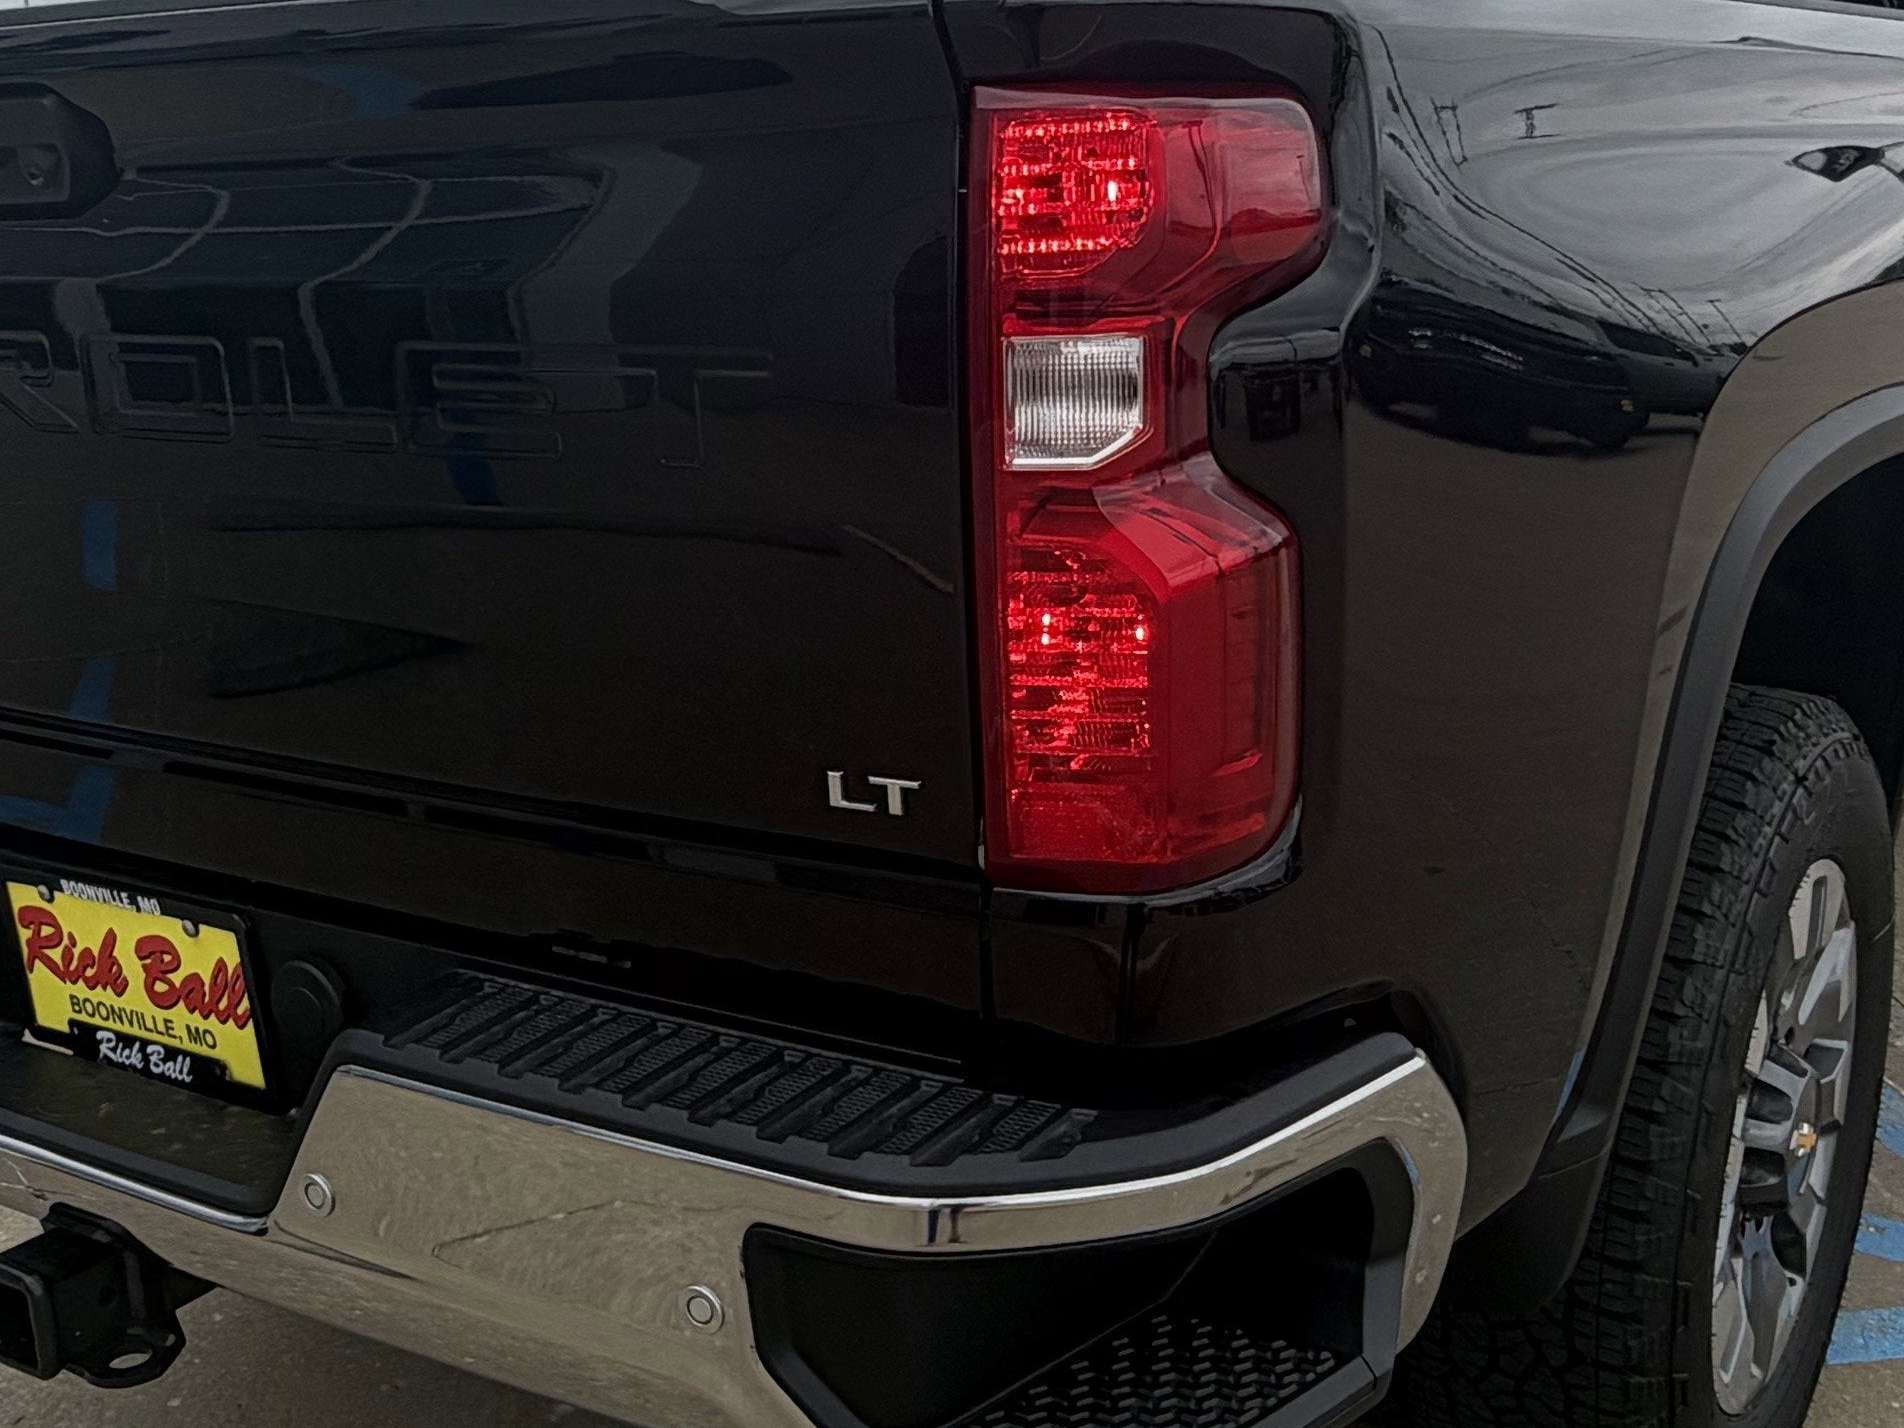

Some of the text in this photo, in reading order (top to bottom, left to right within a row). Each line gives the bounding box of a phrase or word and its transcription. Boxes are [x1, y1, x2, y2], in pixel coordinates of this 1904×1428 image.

[827, 771, 922, 816] LT
[60, 878, 161, 916] BOONVILLE, MO
[18, 905, 251, 1030] Rick Ball
[69, 994, 218, 1050] BOONVILLE, MO
[96, 1031, 193, 1084] Rick Ball
